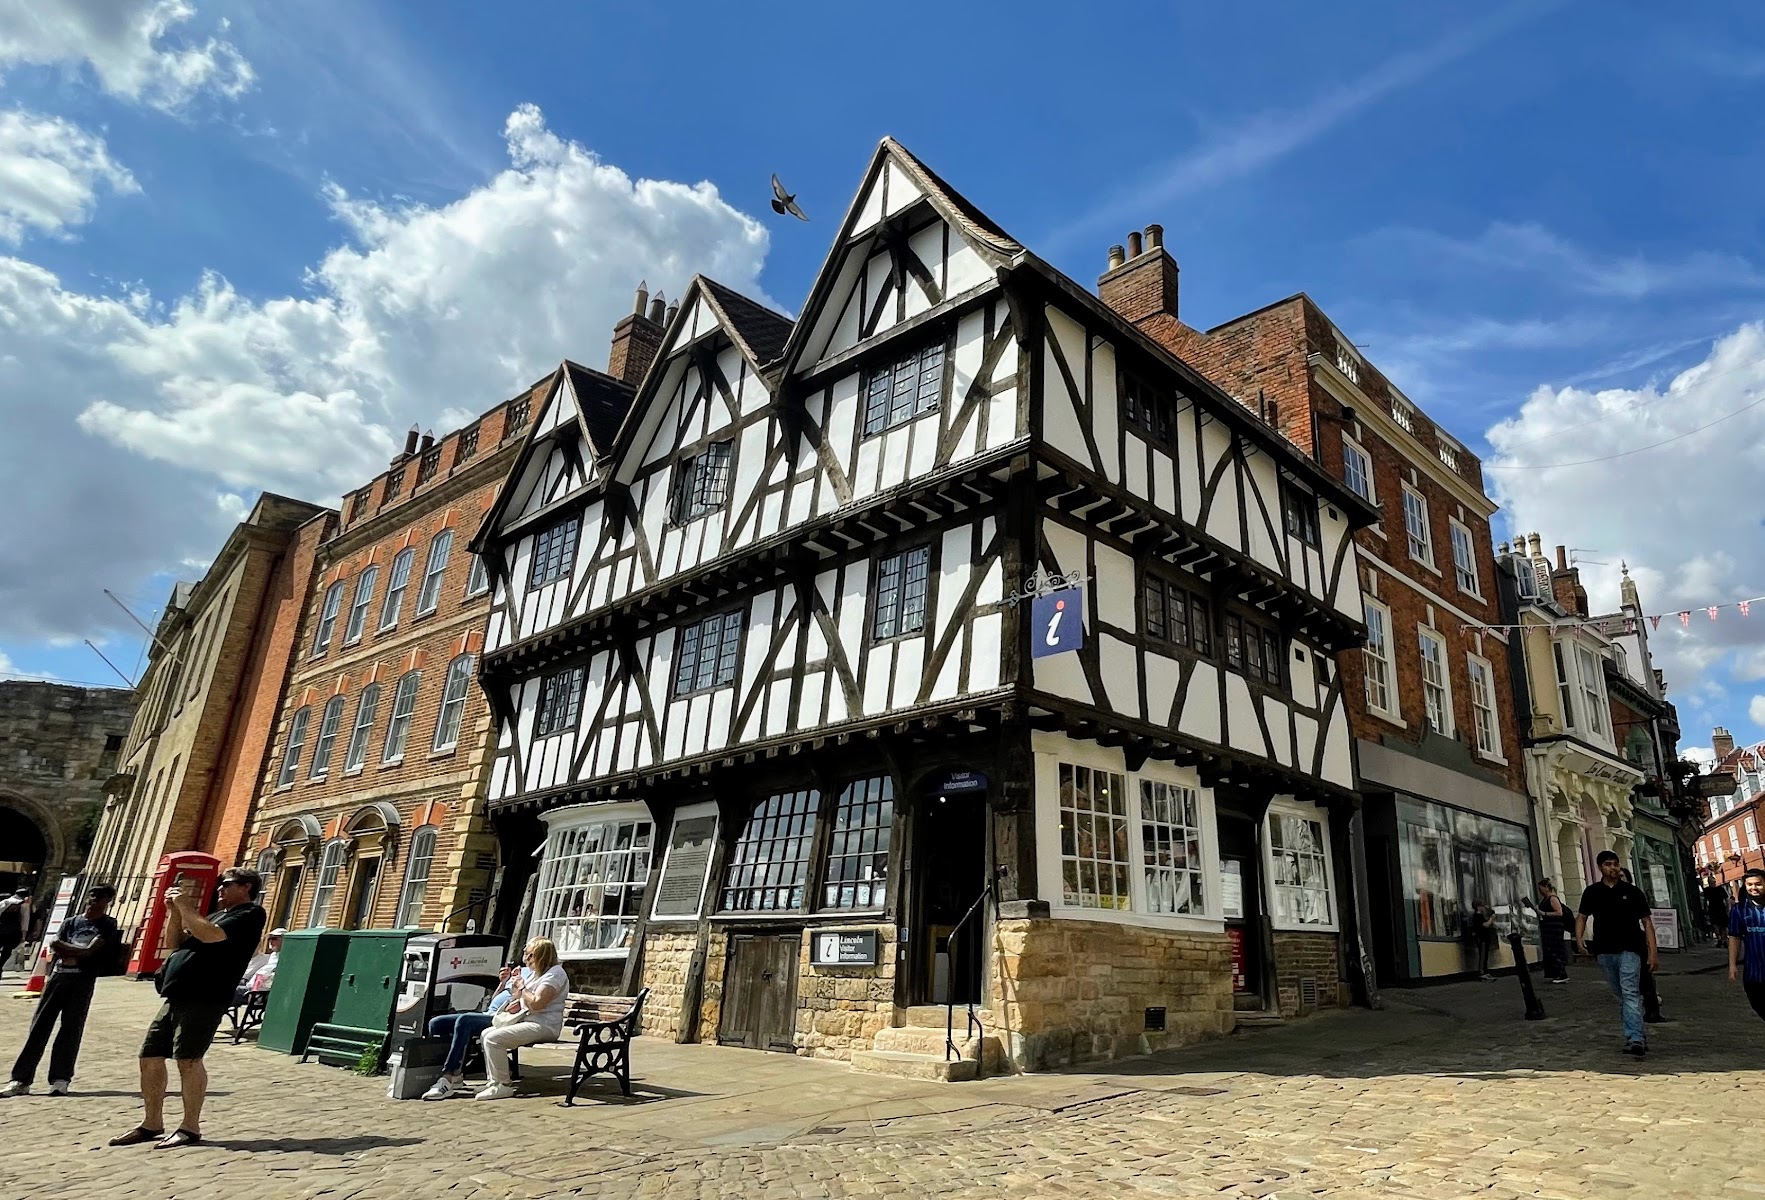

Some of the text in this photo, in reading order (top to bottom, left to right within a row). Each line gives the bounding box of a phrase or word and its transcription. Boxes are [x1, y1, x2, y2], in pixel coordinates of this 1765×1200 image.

[951, 772, 970, 780] Visitor
[943, 780, 978, 790] Information
[840, 935, 863, 944] Lincoln
[840, 944, 856, 952] Visitor
[463, 957, 488, 965] Lincoln
